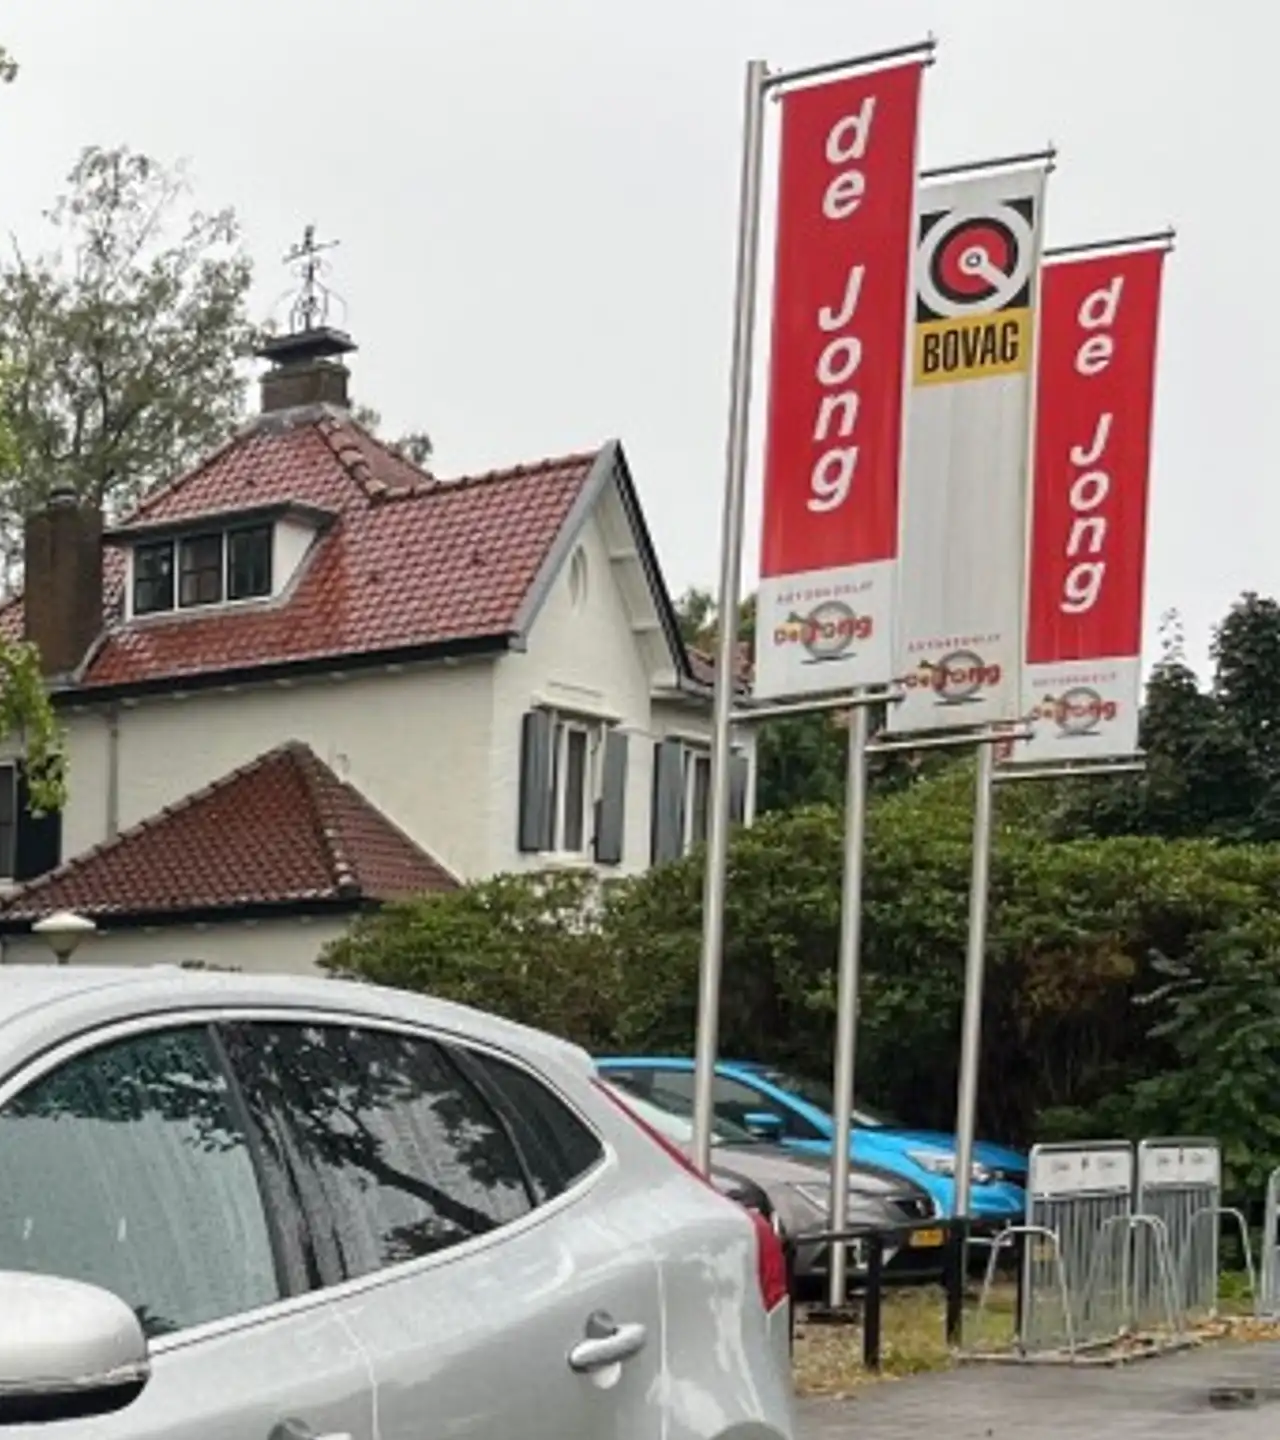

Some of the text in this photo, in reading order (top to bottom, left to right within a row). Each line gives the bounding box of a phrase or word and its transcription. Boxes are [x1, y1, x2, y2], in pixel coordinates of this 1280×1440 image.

[821, 96, 876, 220] de
[922, 321, 1020, 375] BOVAG
[1074, 274, 1125, 377] de
[807, 265, 866, 513] Jong
[1059, 412, 1114, 614] Jong
